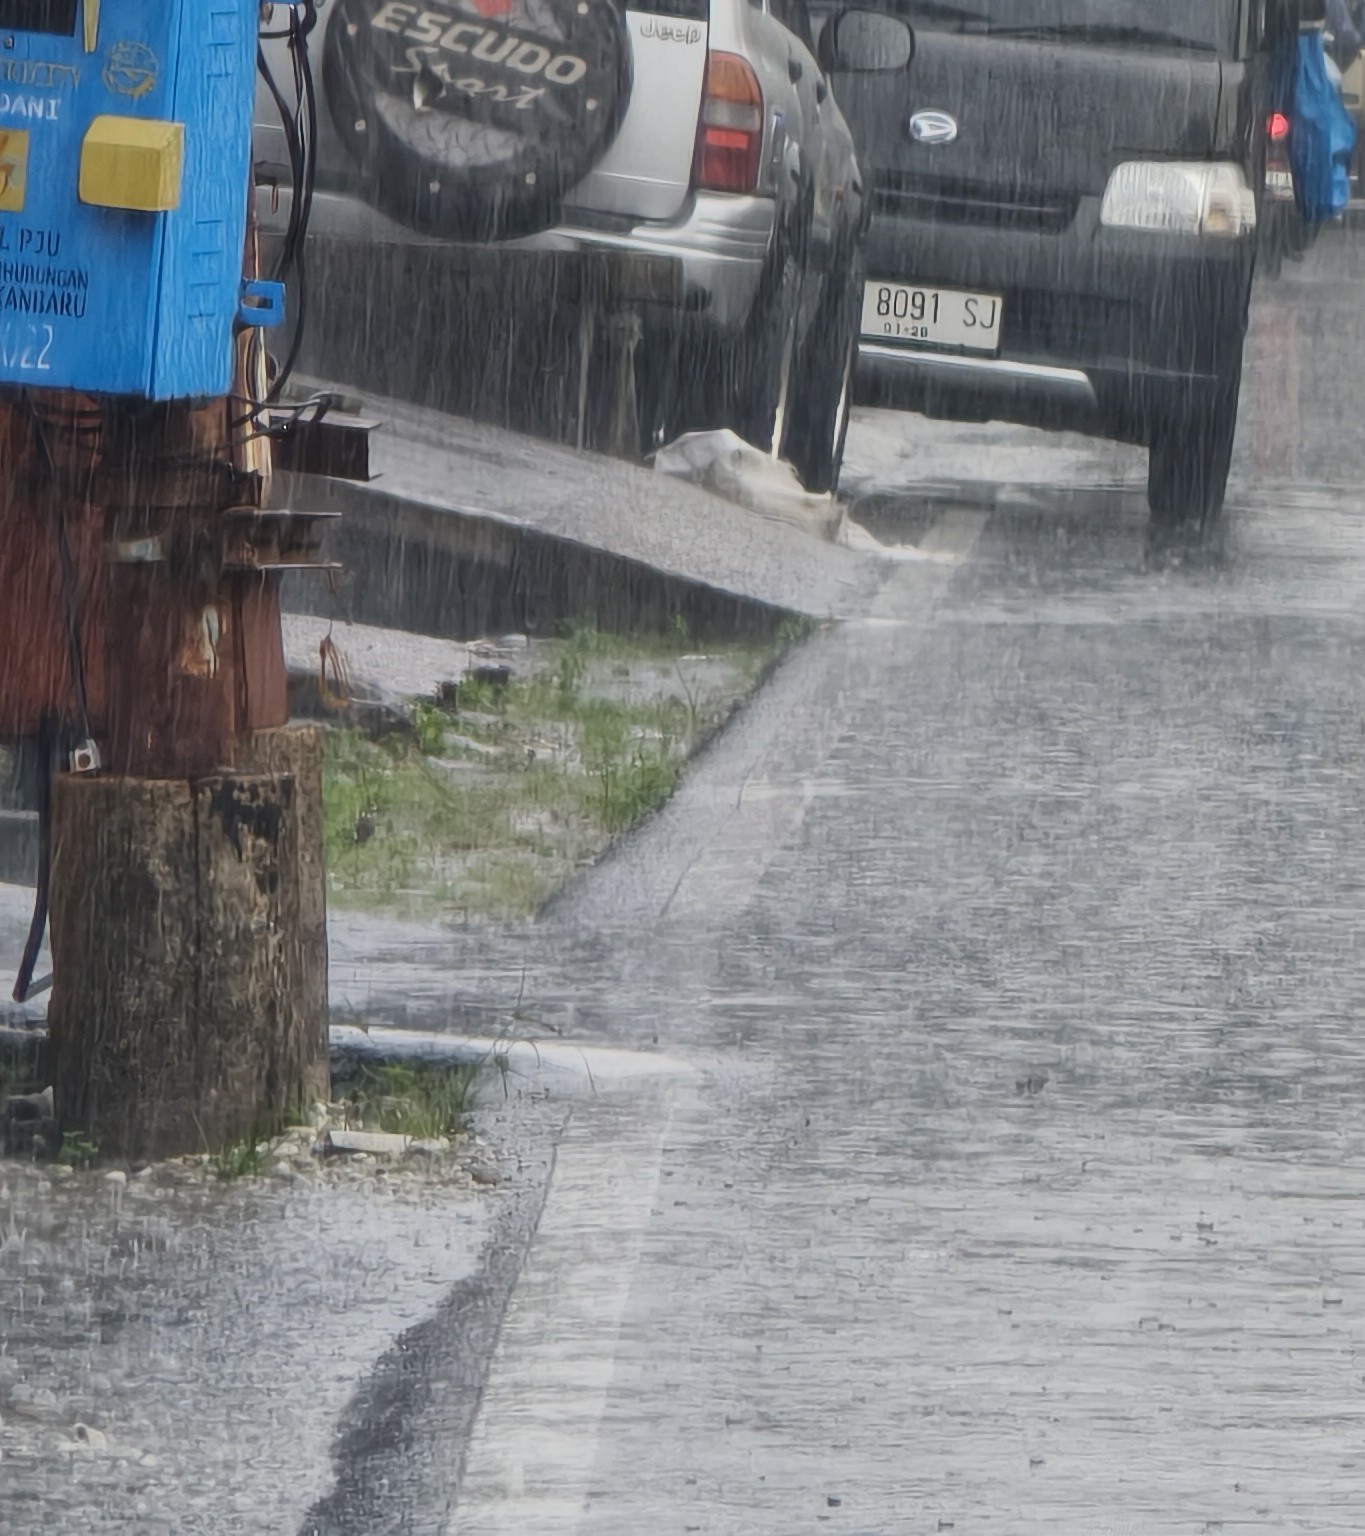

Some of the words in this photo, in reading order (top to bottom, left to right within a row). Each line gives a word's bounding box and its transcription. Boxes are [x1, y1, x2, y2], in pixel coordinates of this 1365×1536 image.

[370, 1, 587, 86] ESCUDO
[20, 227, 61, 257] PJU
[876, 286, 940, 325] 8091
[962, 297, 997, 330] SJ
